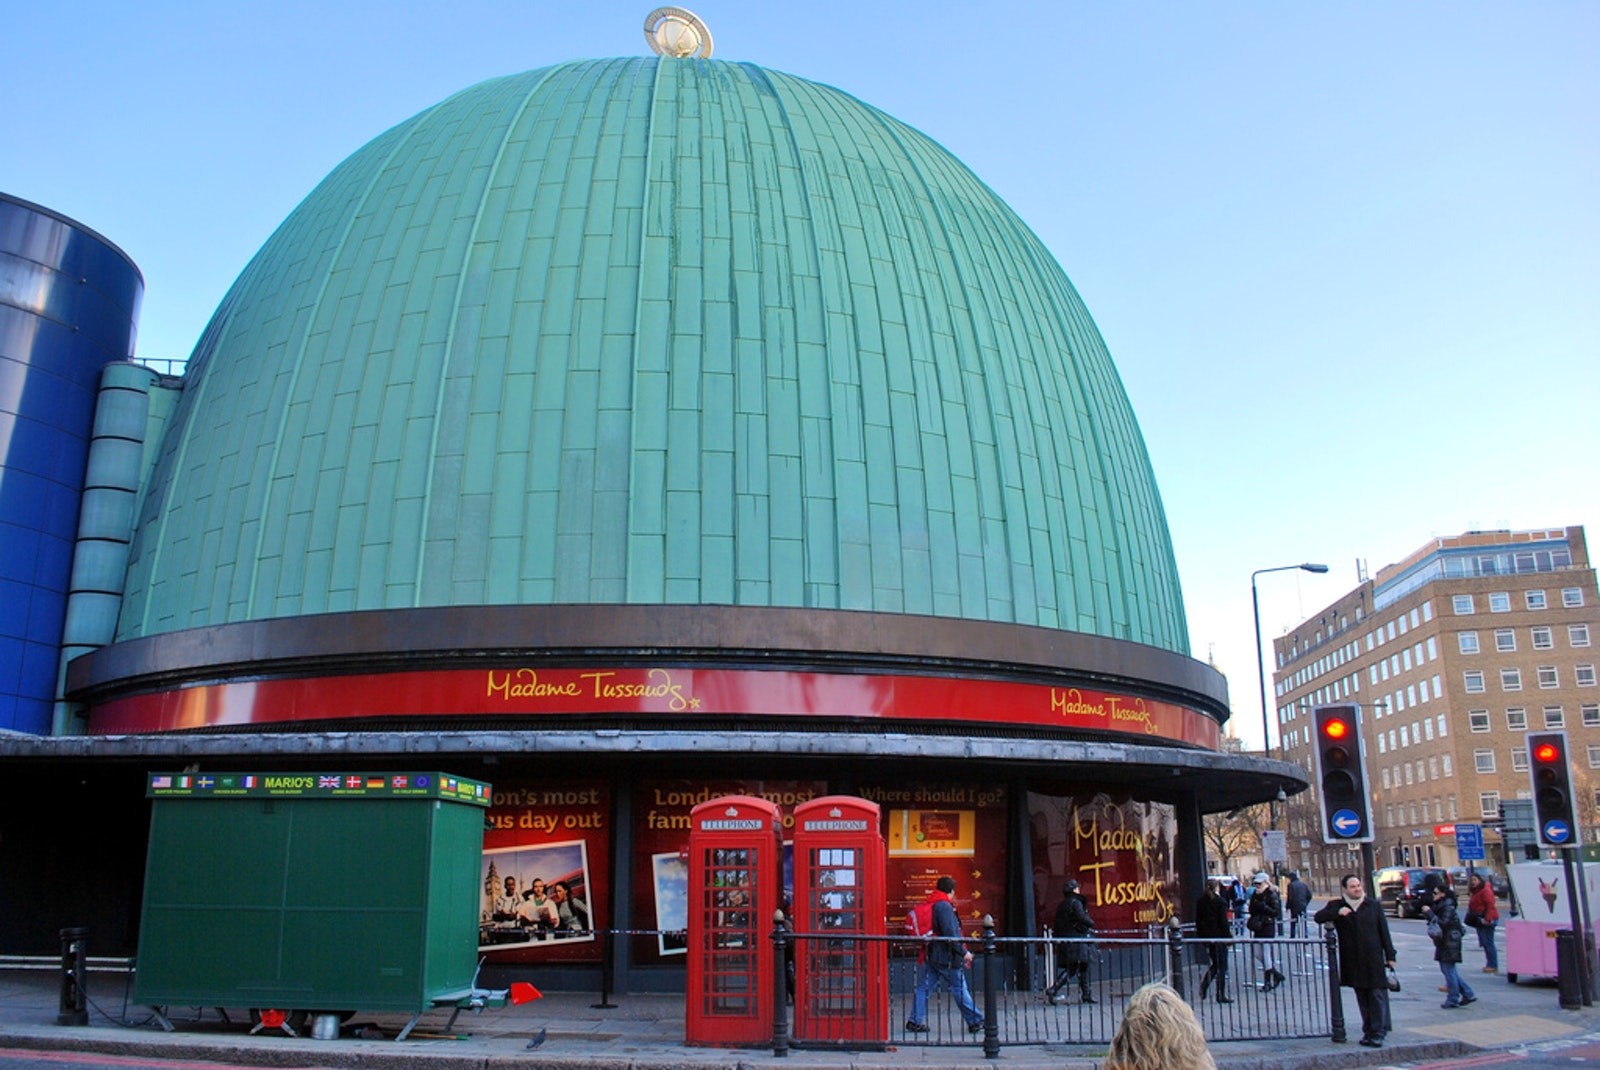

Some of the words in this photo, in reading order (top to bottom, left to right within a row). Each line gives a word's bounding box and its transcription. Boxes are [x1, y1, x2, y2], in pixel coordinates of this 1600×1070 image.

[487, 668, 582, 700] Madame
[580, 668, 687, 711] Tussauds
[1051, 688, 1107, 716] Madame
[1104, 698, 1153, 735] Tussauds
[264, 777, 313, 788] MARIO'S
[493, 788, 538, 805] on's
[543, 788, 599, 805] most
[761, 789, 816, 806] most
[858, 785, 911, 801] Where
[915, 786, 965, 802] should
[969, 788, 975, 802] I
[977, 788, 1005, 807] go?
[519, 810, 559, 833] day
[563, 811, 603, 829] out
[648, 810, 692, 829] fam
[703, 820, 760, 830] TELEPHONE
[806, 821, 866, 831] TELEPHONE
[1079, 854, 1167, 923] Tussauds
